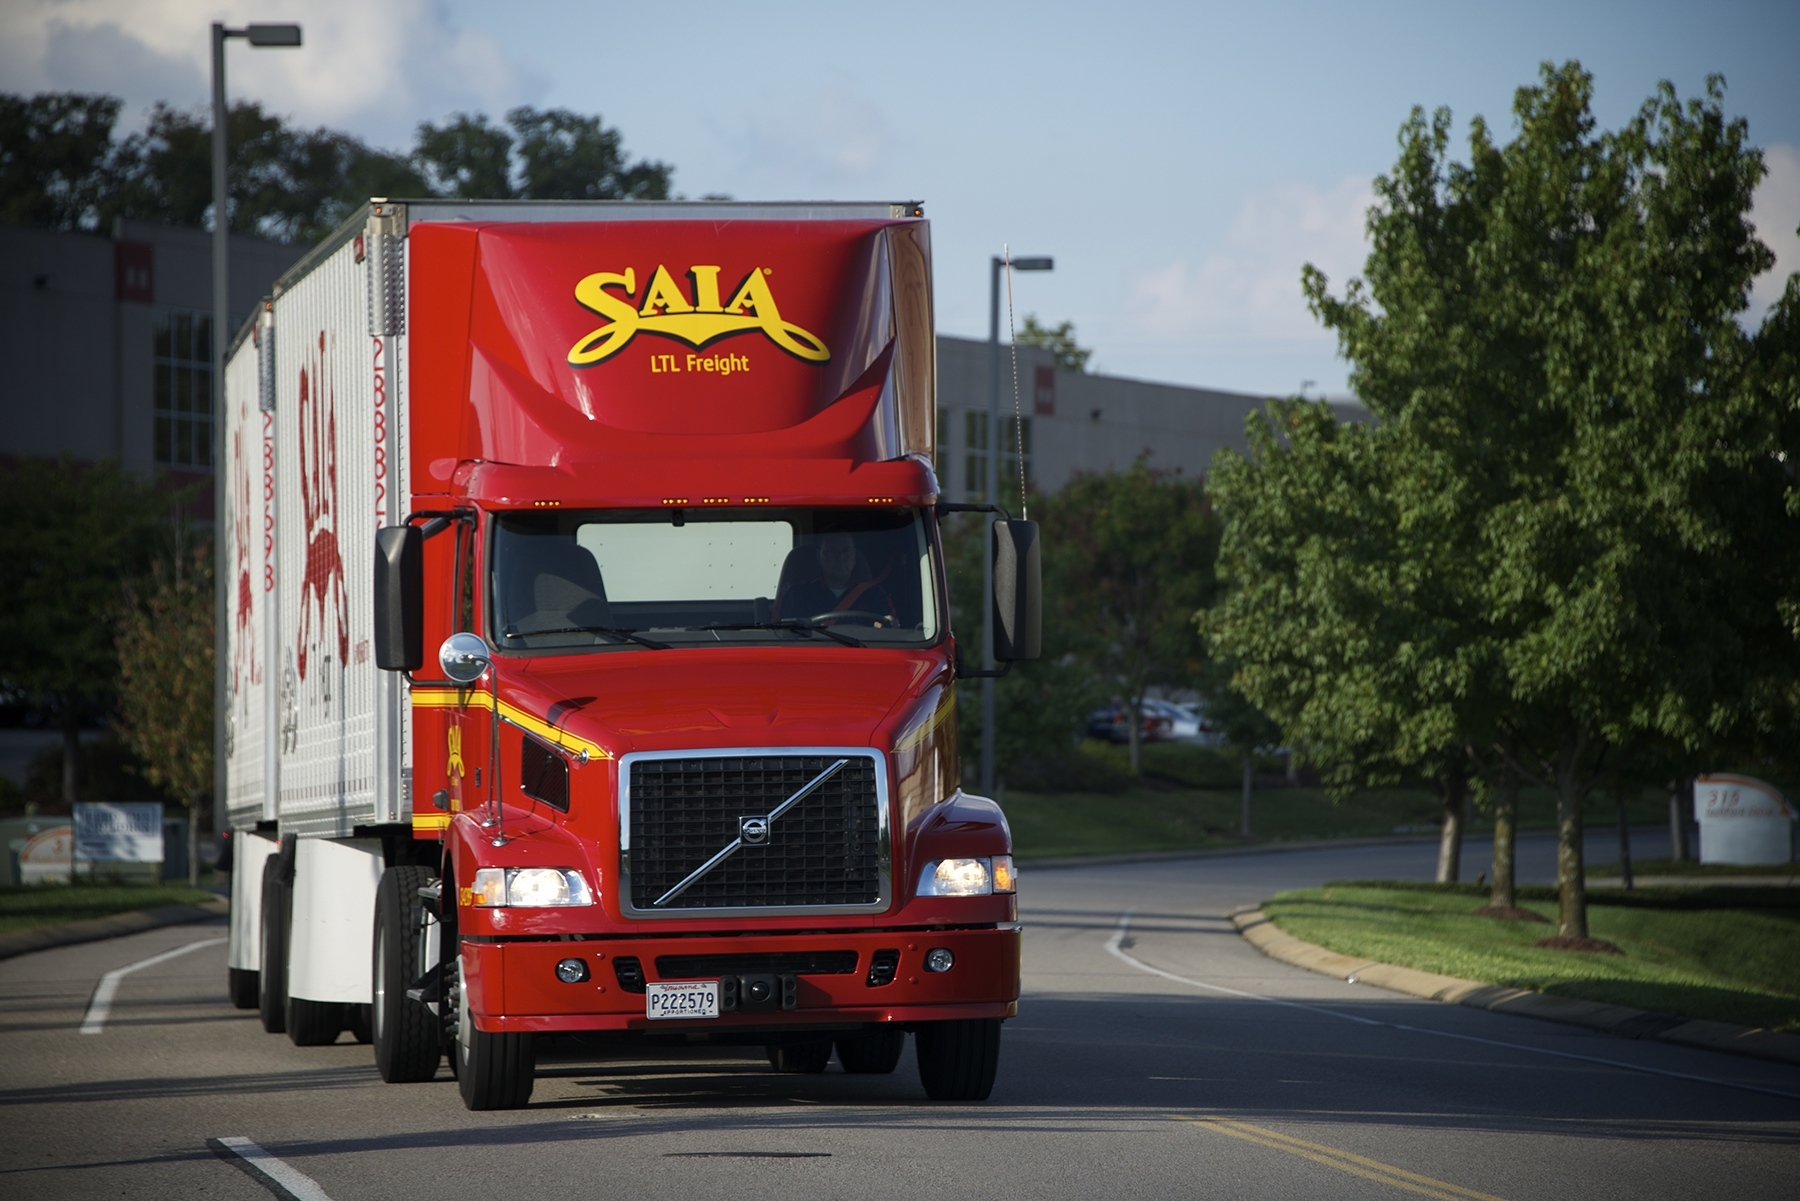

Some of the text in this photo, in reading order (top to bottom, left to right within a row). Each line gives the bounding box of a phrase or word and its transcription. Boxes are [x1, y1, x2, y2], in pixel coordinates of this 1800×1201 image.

[567, 264, 831, 368] SAIA
[651, 353, 750, 375] LTL Freight
[651, 992, 714, 1010] P222579
